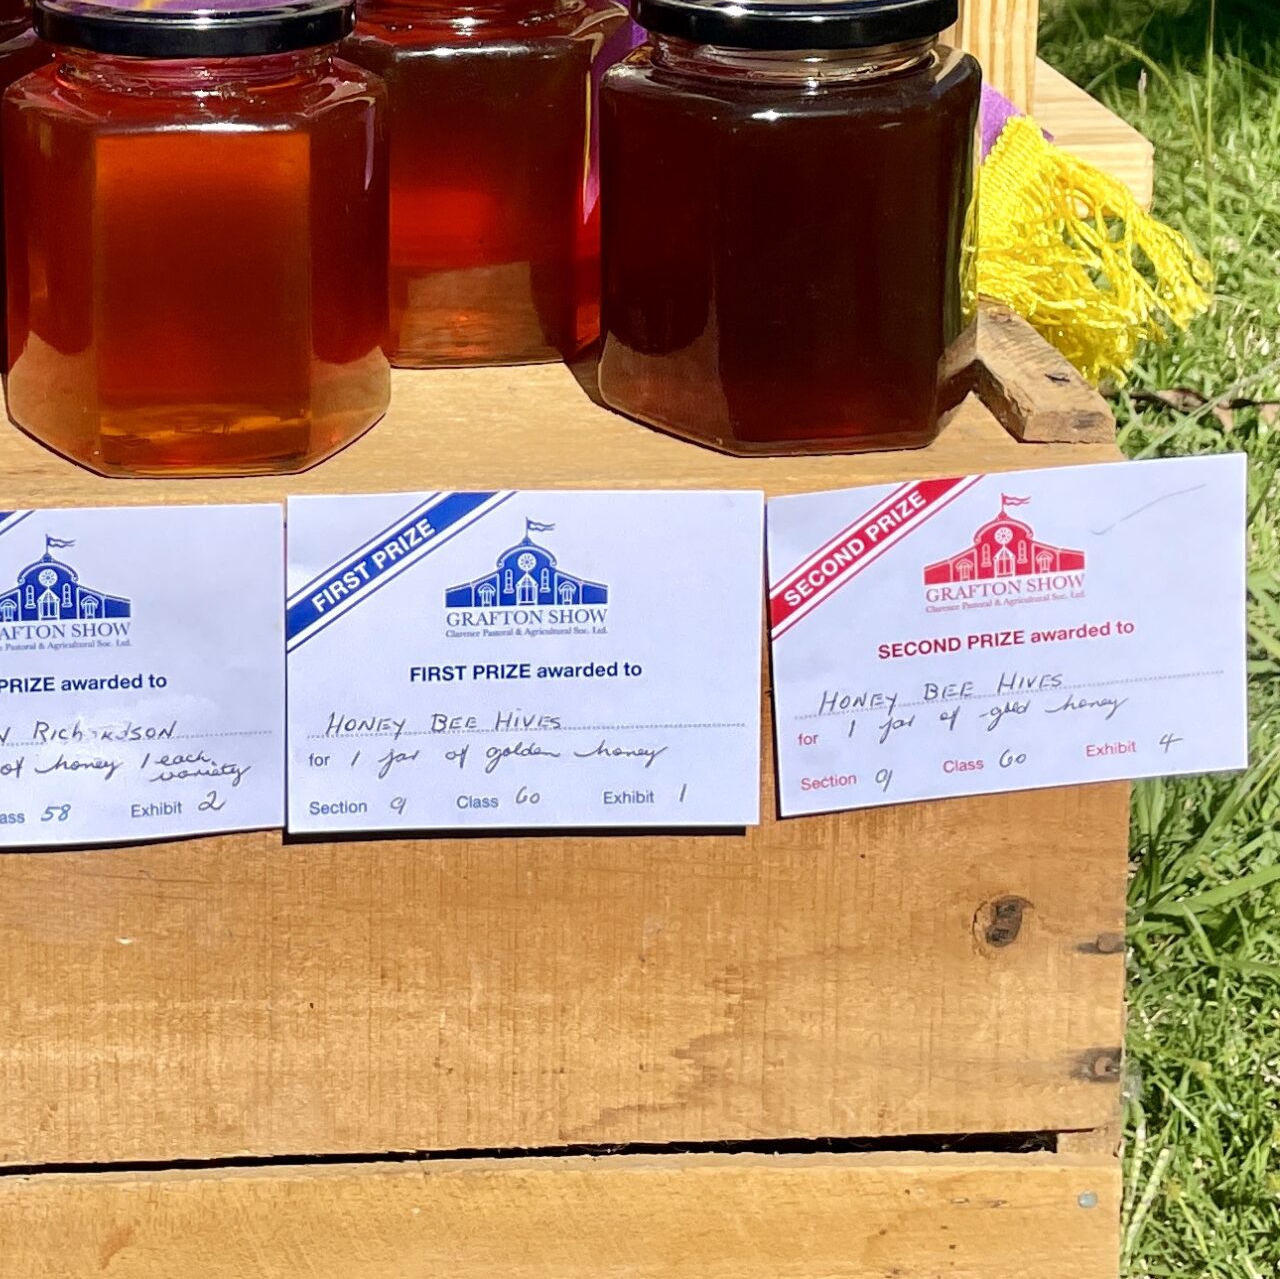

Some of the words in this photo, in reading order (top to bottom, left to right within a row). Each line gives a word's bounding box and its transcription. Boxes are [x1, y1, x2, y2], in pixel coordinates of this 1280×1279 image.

[783, 537, 866, 607] SECOND
[868, 491, 927, 542] PRIZE
[311, 562, 372, 614] FIRST
[372, 519, 436, 572] PRIZE
[926, 580, 1022, 602] GRAFTON
[1027, 574, 1085, 592] SHOW
[71, 622, 131, 638] SHOW
[446, 610, 543, 626] GRAFTON
[548, 608, 608, 625] SHOW
[877, 638, 962, 659] SECOND
[967, 631, 1026, 651] PRIZE
[1030, 624, 1112, 645] awarded
[1117, 621, 1135, 635] to
[60, 675, 142, 692] awarded
[147, 674, 167, 689] to
[410, 665, 468, 683] FIRST
[473, 664, 531, 680] PRIZE
[536, 661, 618, 679] awarded
[624, 662, 642, 677] to
[819, 690, 898, 715] HONEY
[924, 681, 974, 702] BEE
[998, 672, 1064, 691] HIVES
[325, 711, 407, 740] HONEY
[431, 711, 477, 733] BEE
[495, 708, 562, 731] HIVES
[798, 733, 819, 746] for
[940, 705, 961, 731] of
[1044, 696, 1130, 721] honey
[0, 756, 24, 778] of
[35, 754, 122, 780] honey
[154, 750, 211, 766] each
[149, 763, 252, 786] variety
[308, 752, 331, 767] for
[378, 748, 421, 778] jar
[445, 744, 470, 772] of
[485, 743, 561, 774] golden
[573, 740, 668, 769] honey
[801, 772, 857, 790] Section
[943, 757, 984, 774] Class
[998, 750, 1027, 768] 60
[1086, 740, 1137, 757] Exhibit
[1158, 734, 1183, 754] 4
[41, 804, 71, 822] 58
[131, 801, 183, 818] Exhibit
[198, 791, 227, 811] 2
[309, 799, 368, 815] Section
[457, 794, 499, 809] Class
[514, 787, 540, 805] 60
[603, 789, 655, 805] Exhibit
